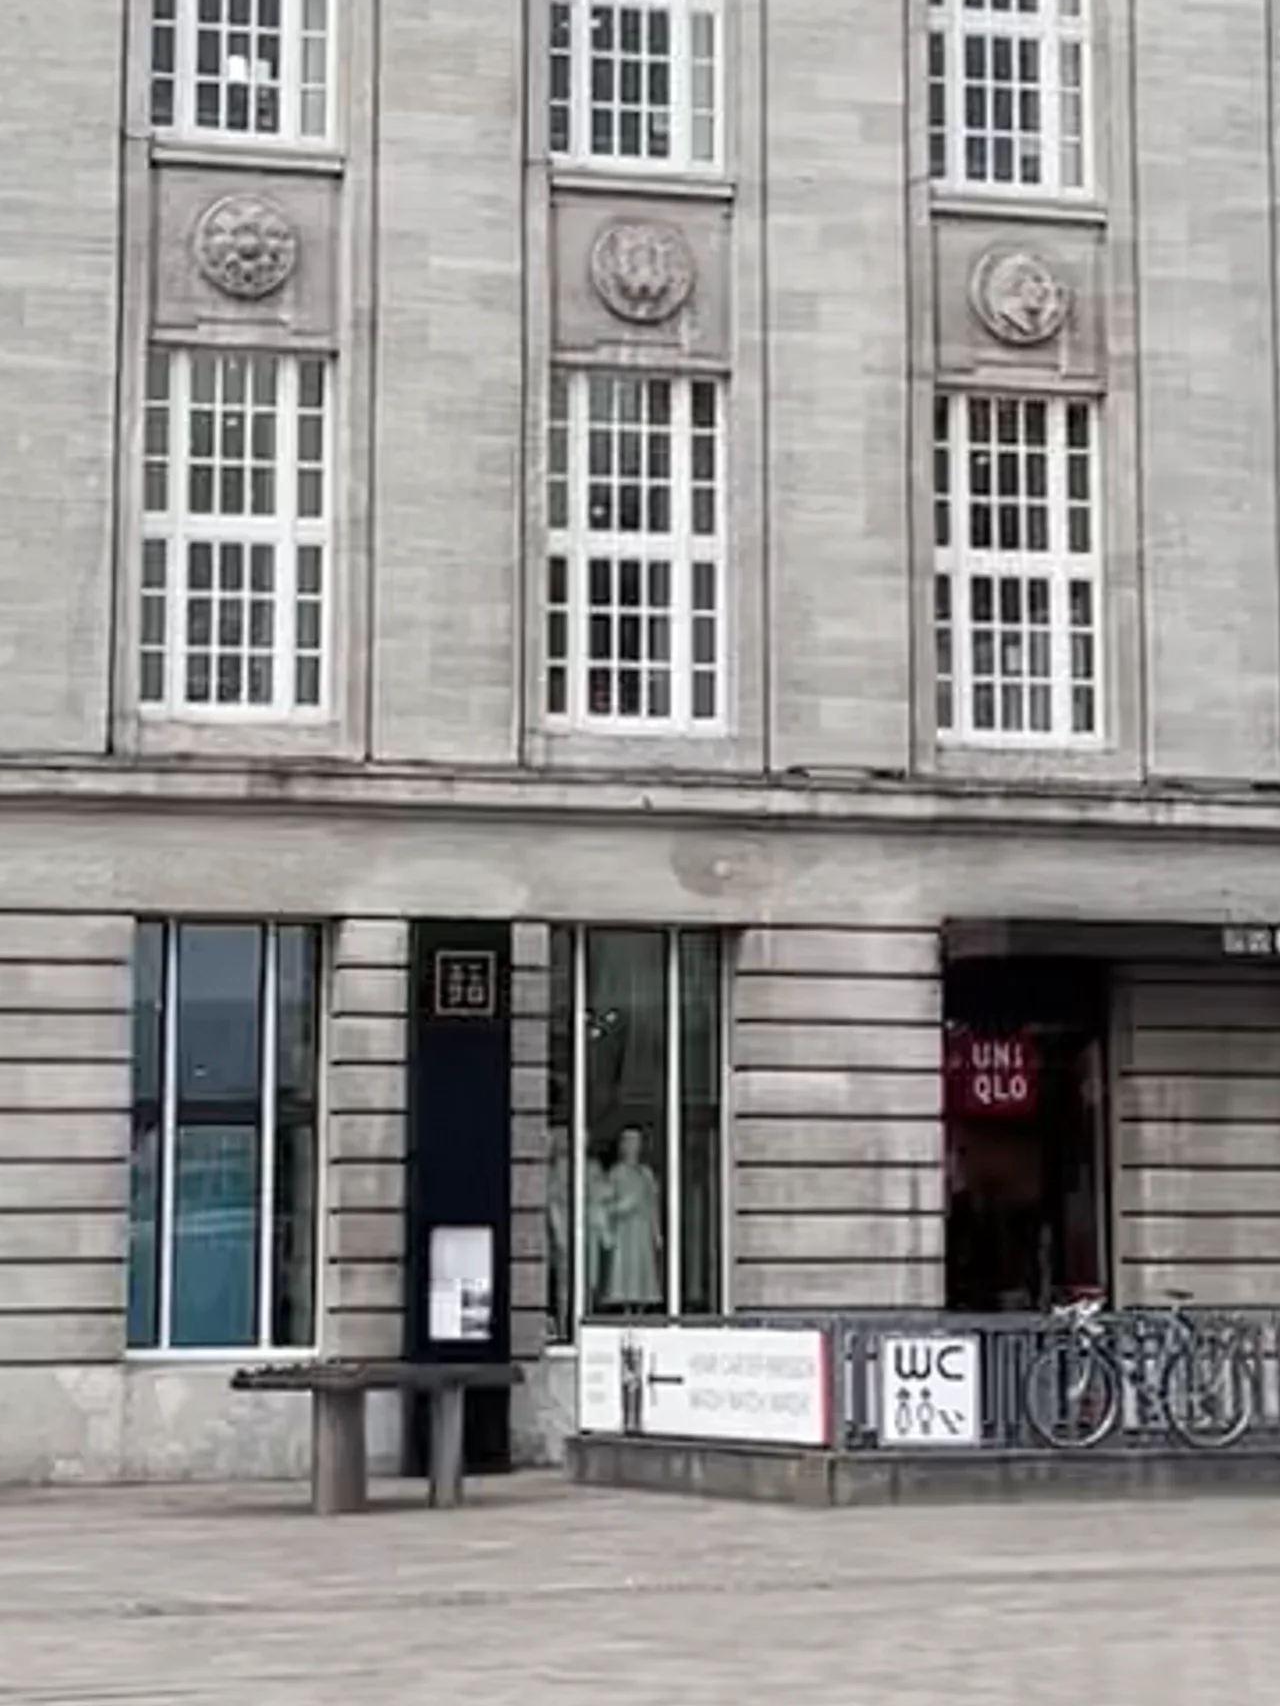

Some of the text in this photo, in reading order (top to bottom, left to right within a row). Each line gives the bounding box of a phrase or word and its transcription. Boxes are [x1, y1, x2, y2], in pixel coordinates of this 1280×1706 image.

[972, 1041, 1023, 1069] UNI
[974, 1074, 1027, 1104] QLO
[894, 1344, 965, 1382] WC
